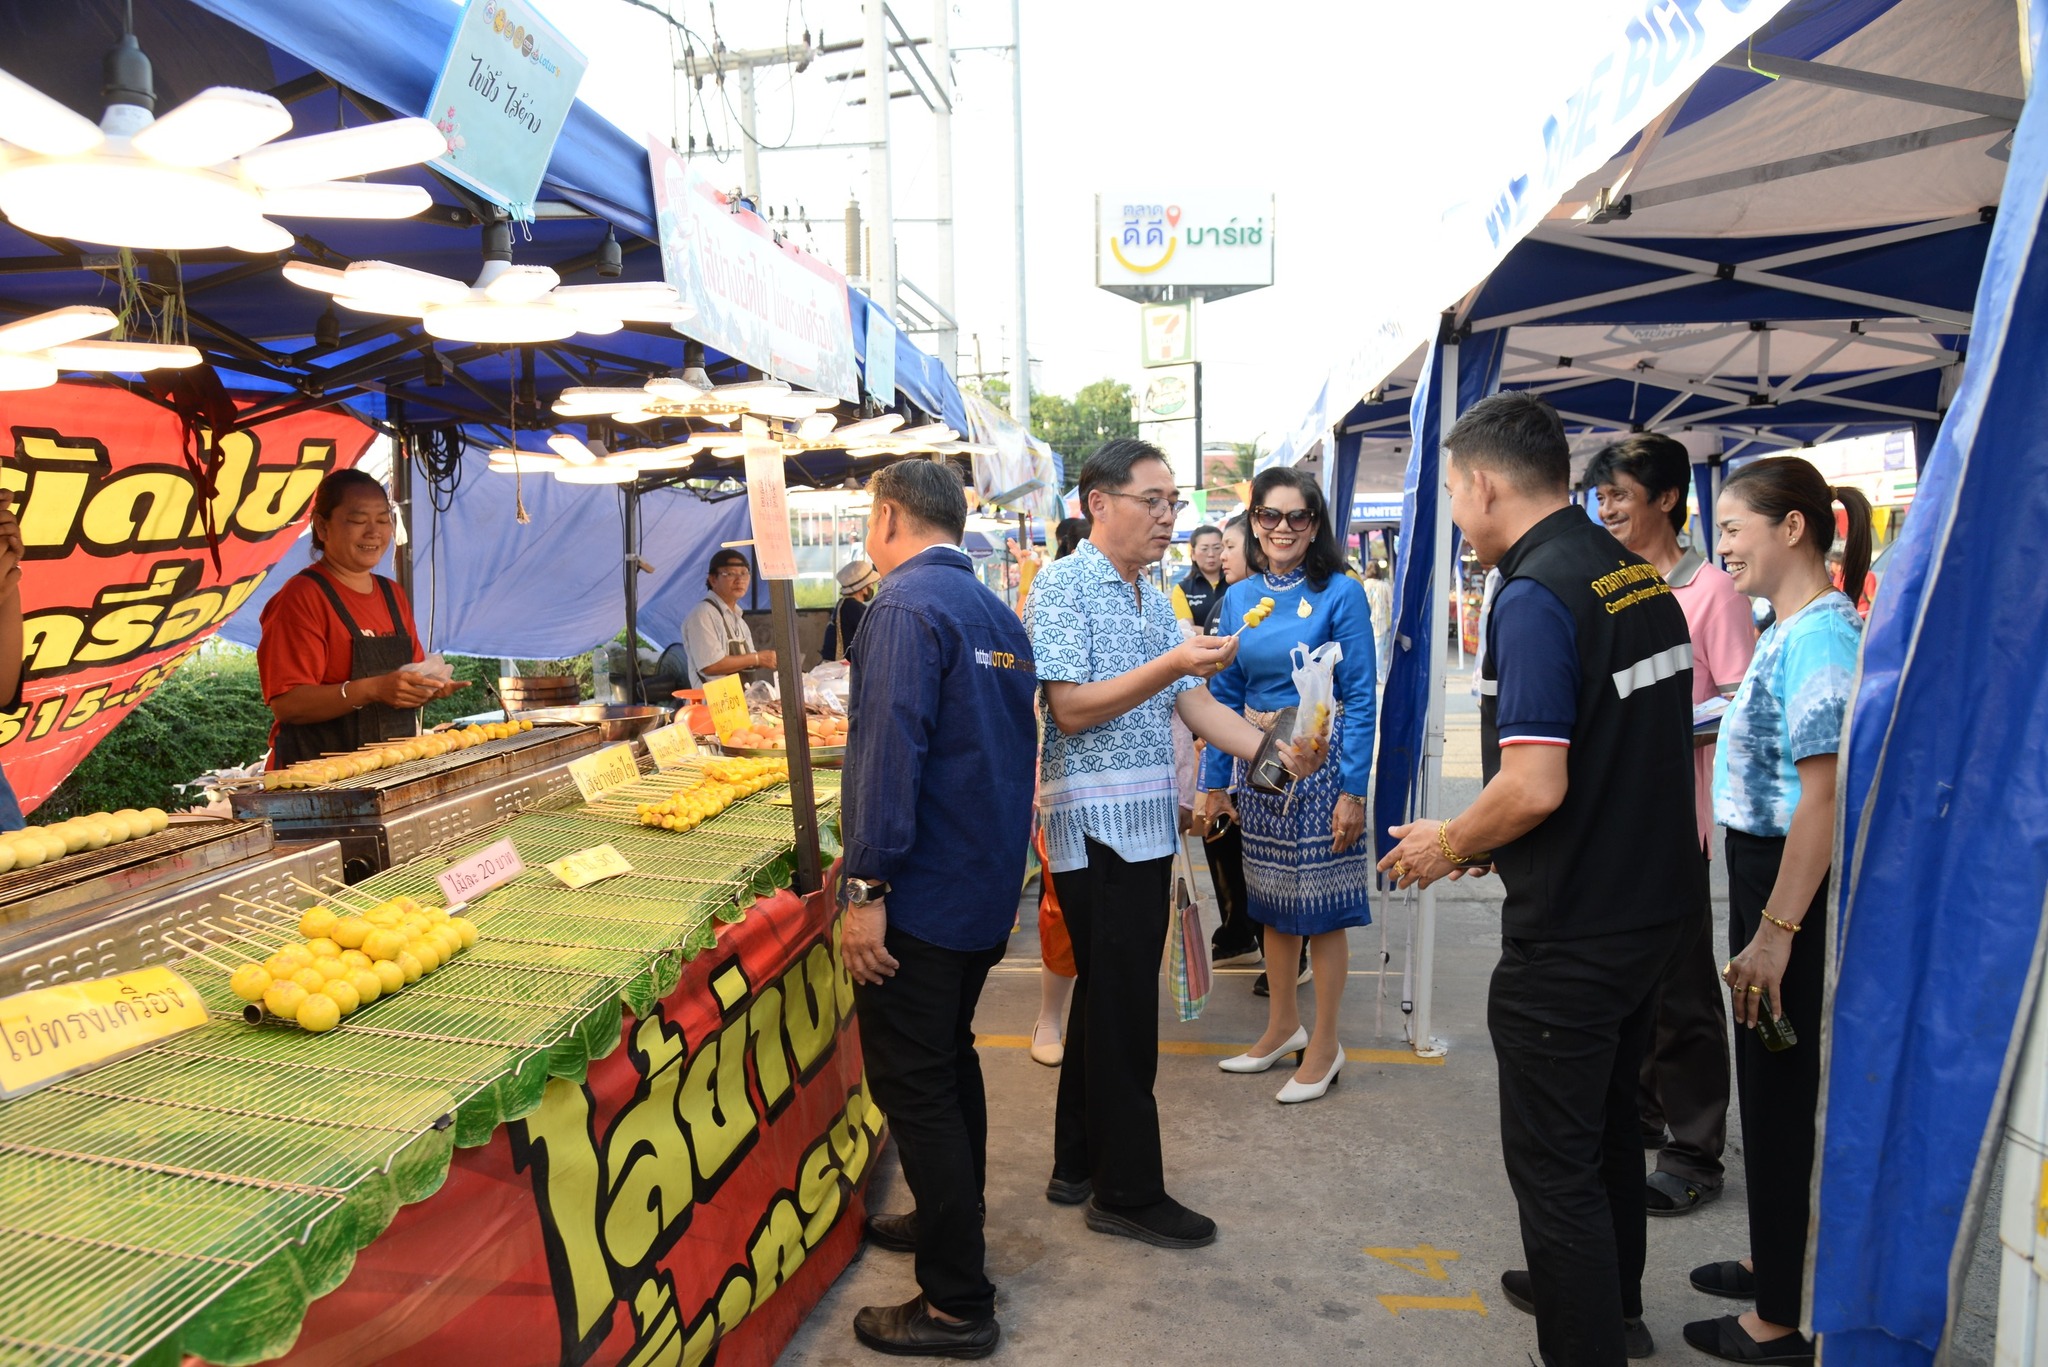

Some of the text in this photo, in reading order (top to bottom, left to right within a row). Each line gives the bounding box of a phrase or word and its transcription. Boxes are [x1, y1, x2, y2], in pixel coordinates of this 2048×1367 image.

[538, 52, 561, 79] Lotus's
[1612, 0, 1752, 125] BGP
[1123, 203, 1163, 217] ตลาด
[1186, 216, 1263, 246] มาร์เช่
[444, 850, 516, 895] ไม้ละ 20 บาท
[595, 852, 616, 869] 50
[0, 978, 186, 1062] ไข่ทรงเครื่อง
